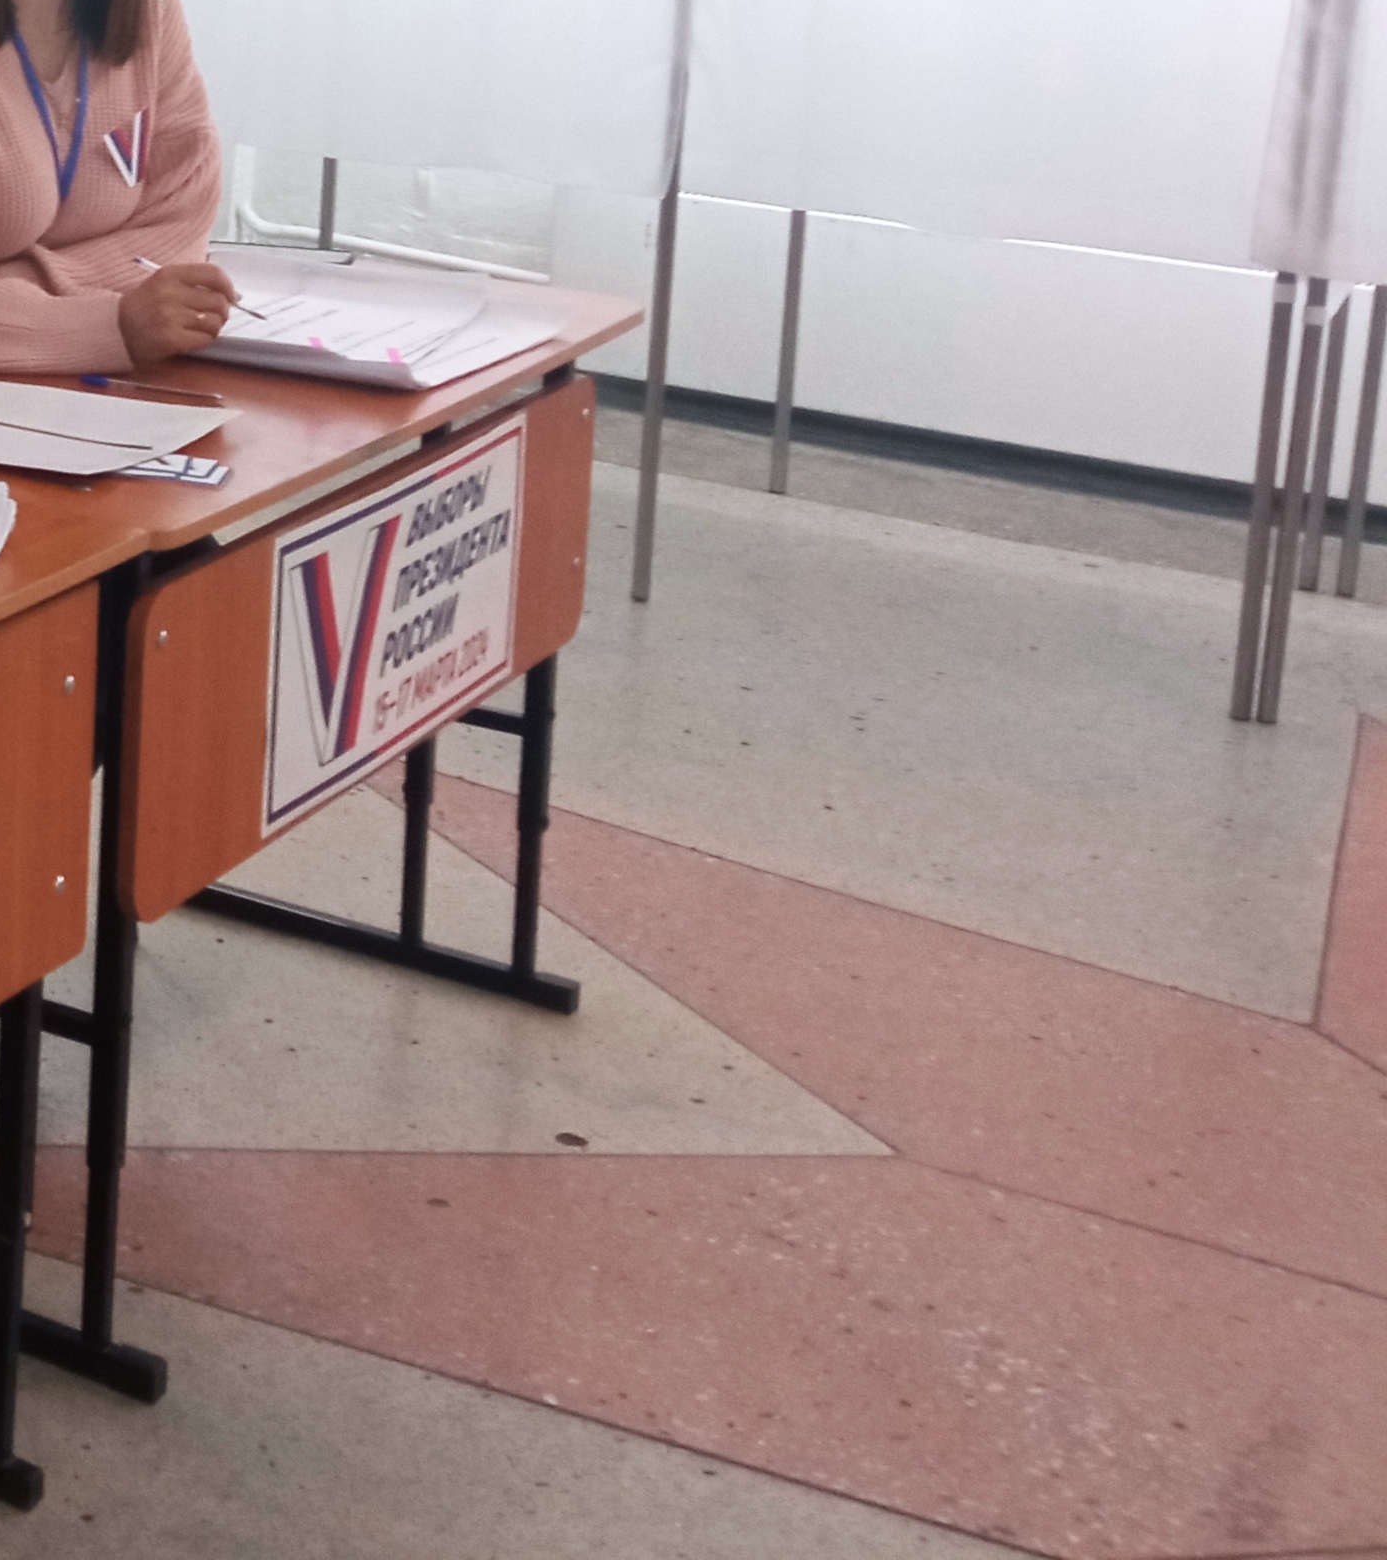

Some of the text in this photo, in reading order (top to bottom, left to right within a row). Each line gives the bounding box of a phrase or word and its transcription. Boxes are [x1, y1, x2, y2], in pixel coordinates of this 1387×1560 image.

[406, 465, 492, 548] ВЫБОРЫ
[393, 508, 513, 614] ПРЕЗИДЕНТА
[379, 592, 460, 679] РОССИИ
